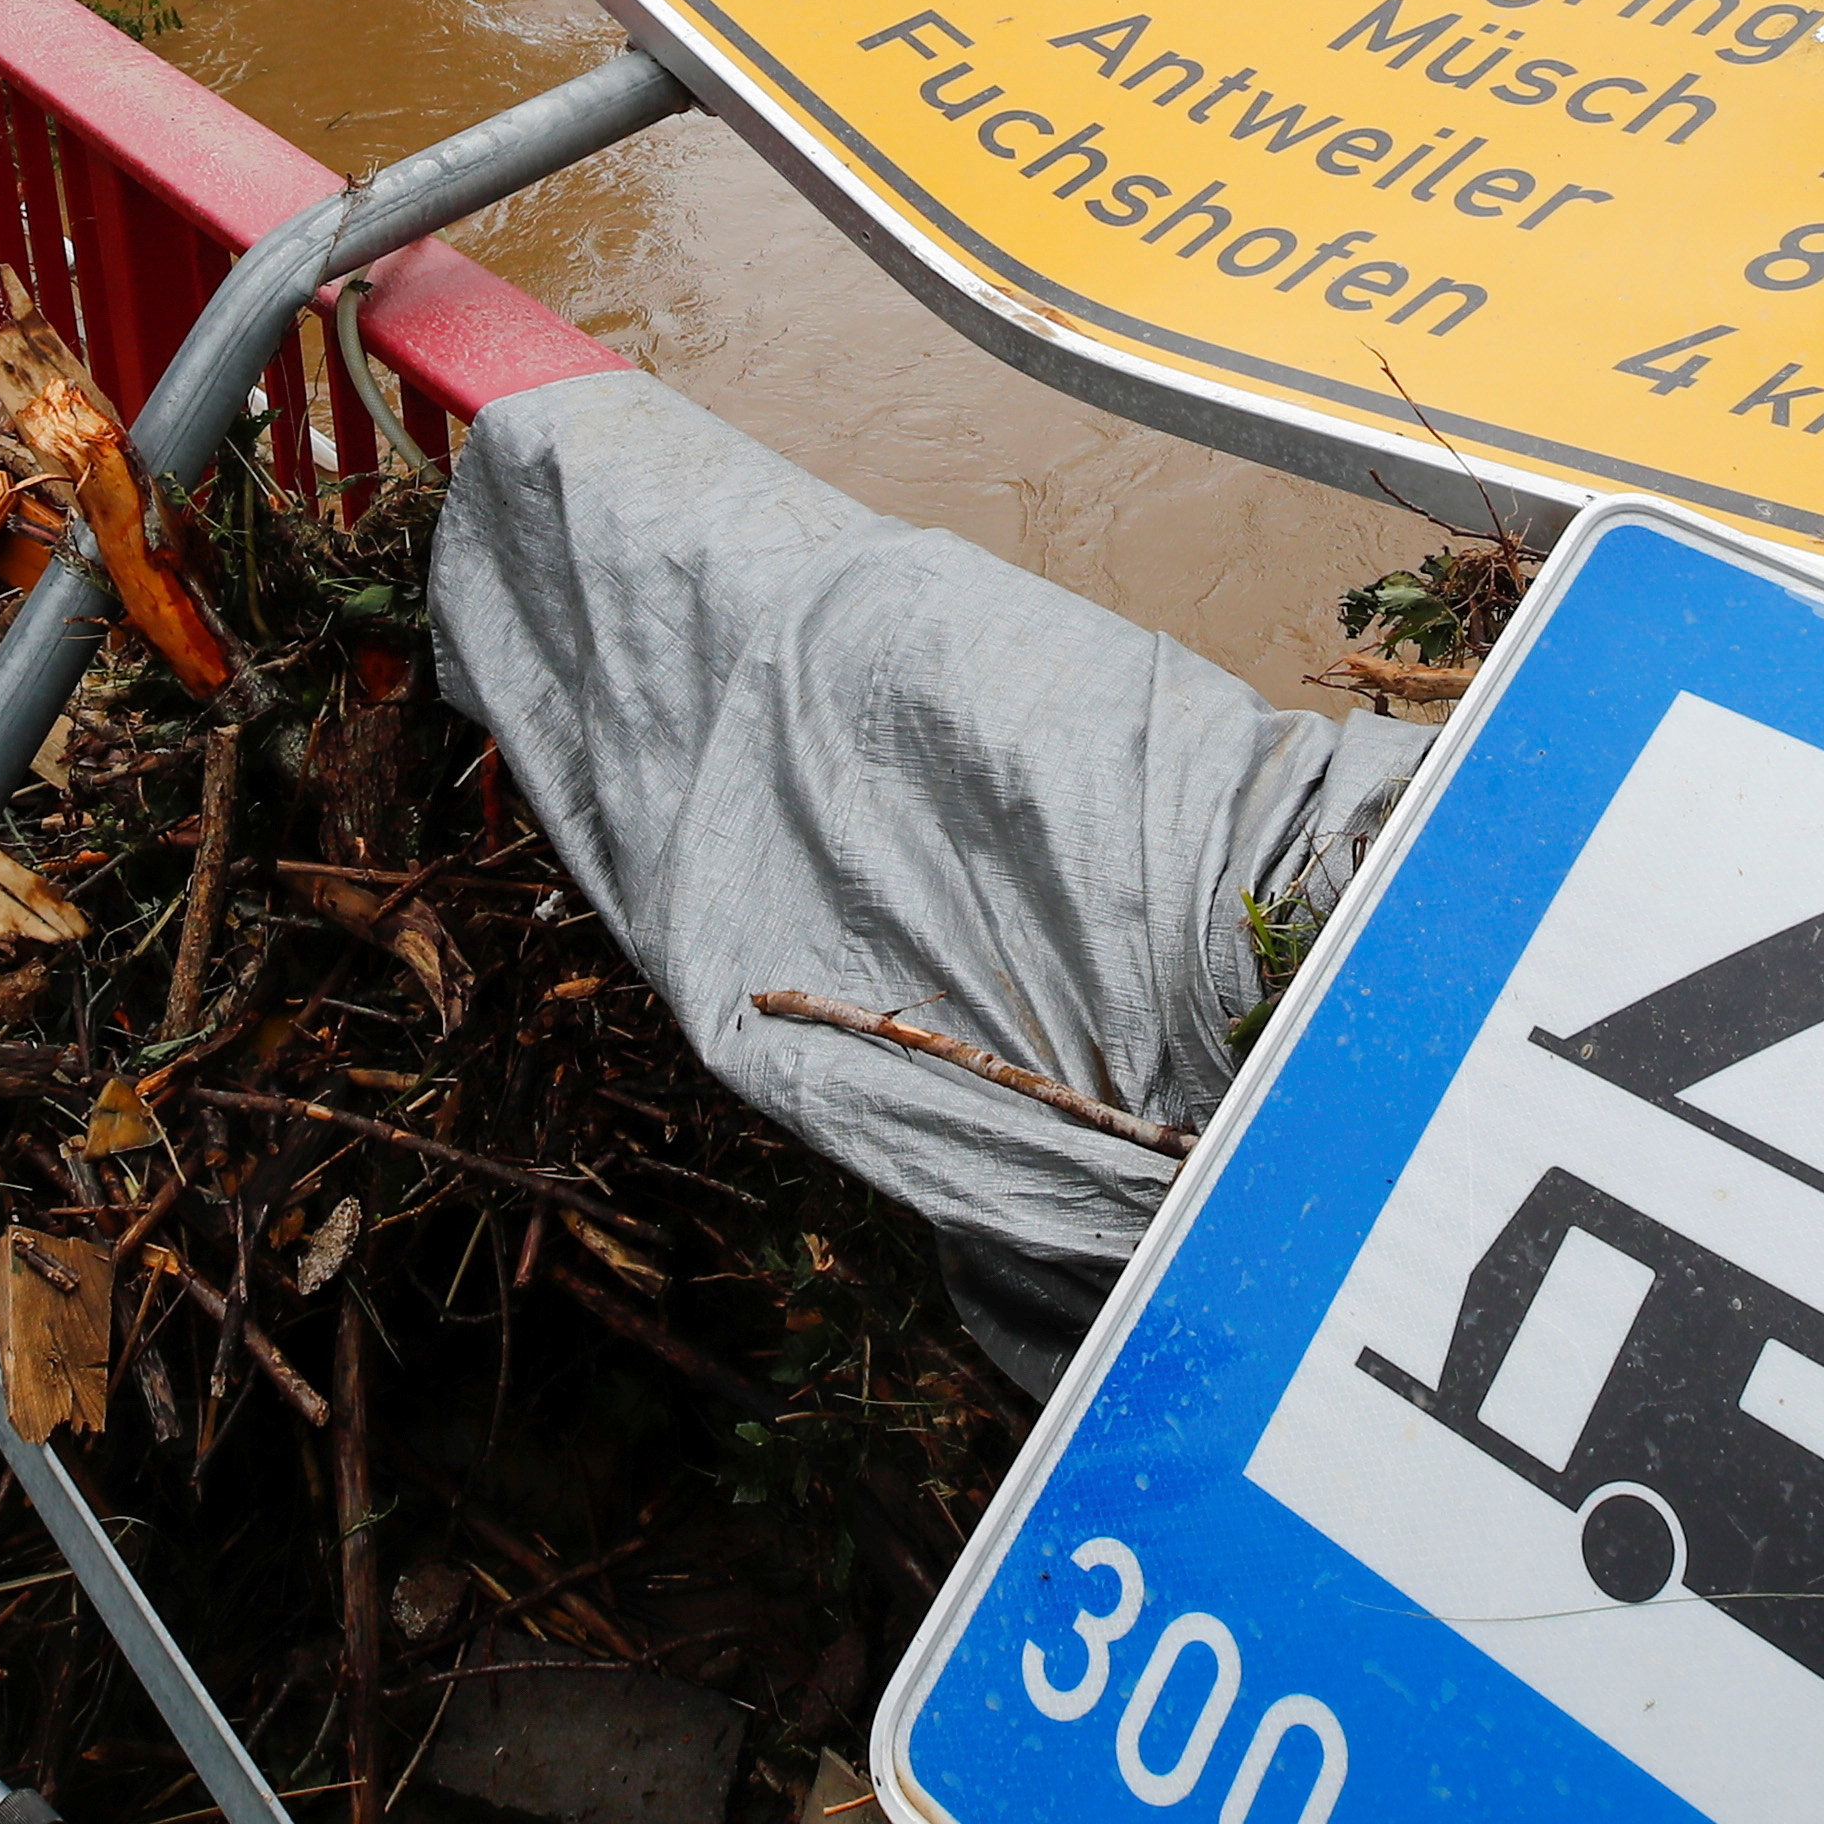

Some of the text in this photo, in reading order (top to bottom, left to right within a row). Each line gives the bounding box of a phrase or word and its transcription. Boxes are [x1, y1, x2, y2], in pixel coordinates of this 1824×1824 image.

[859, 10, 1488, 336] Fuchshofen
[1614, 325, 1737, 396] 4
[1049, 15, 1613, 230] Antweiler
[1021, 1536, 1349, 1824] 300
